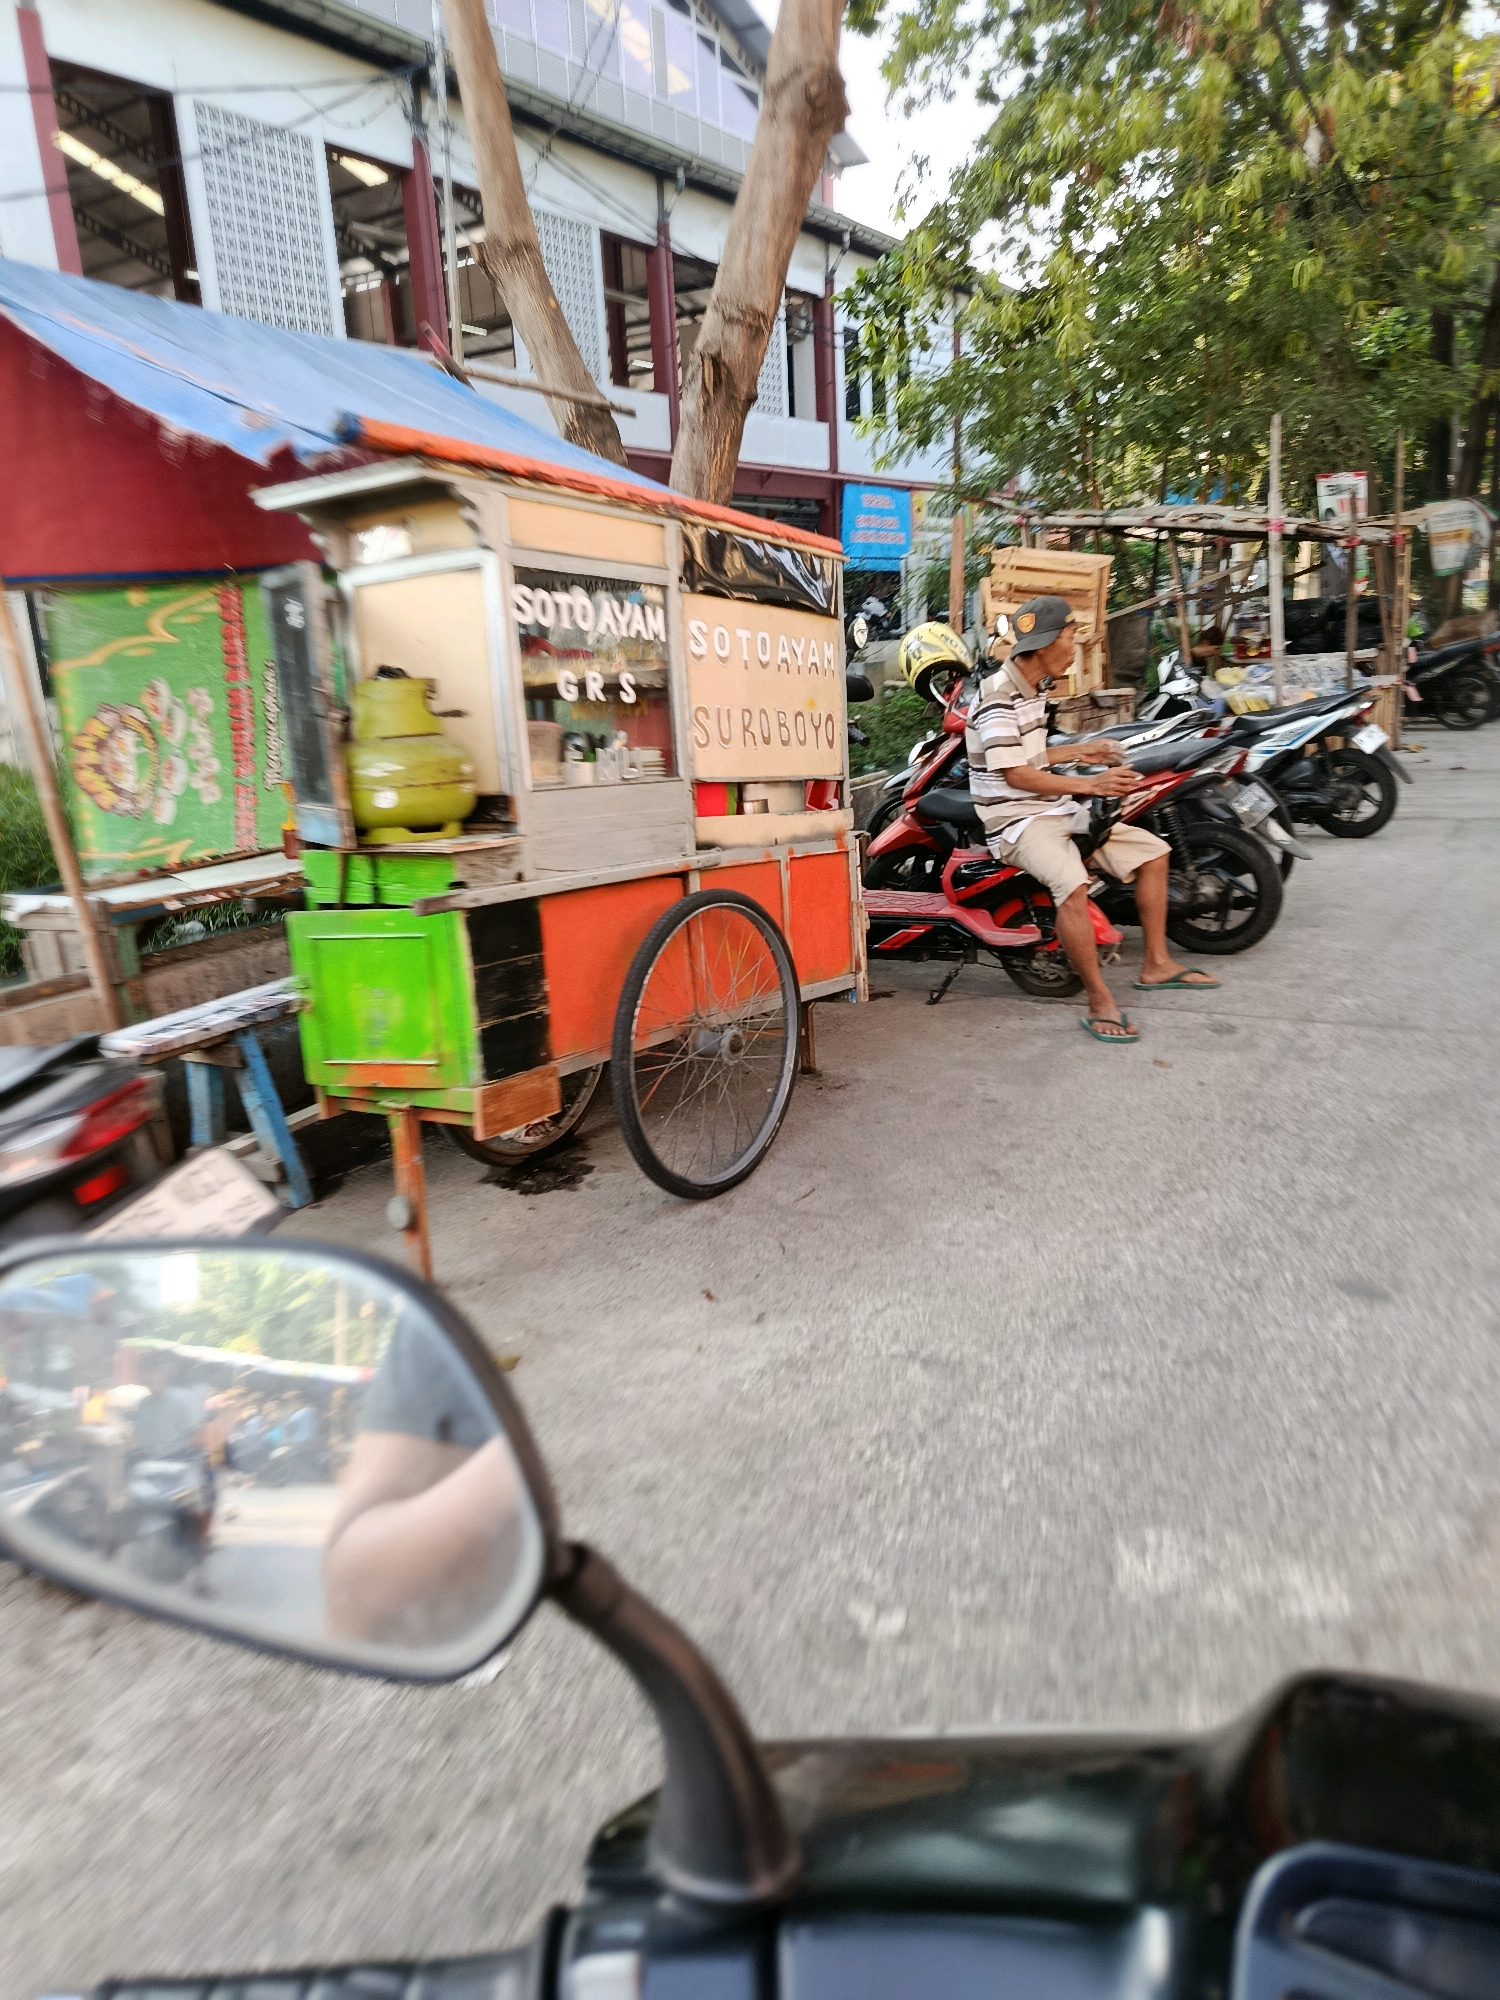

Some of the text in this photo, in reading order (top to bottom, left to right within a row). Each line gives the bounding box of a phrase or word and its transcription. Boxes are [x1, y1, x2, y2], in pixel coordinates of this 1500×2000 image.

[510, 583, 667, 643] SOTO AYAM
[692, 704, 837, 751] SUROBOYO
